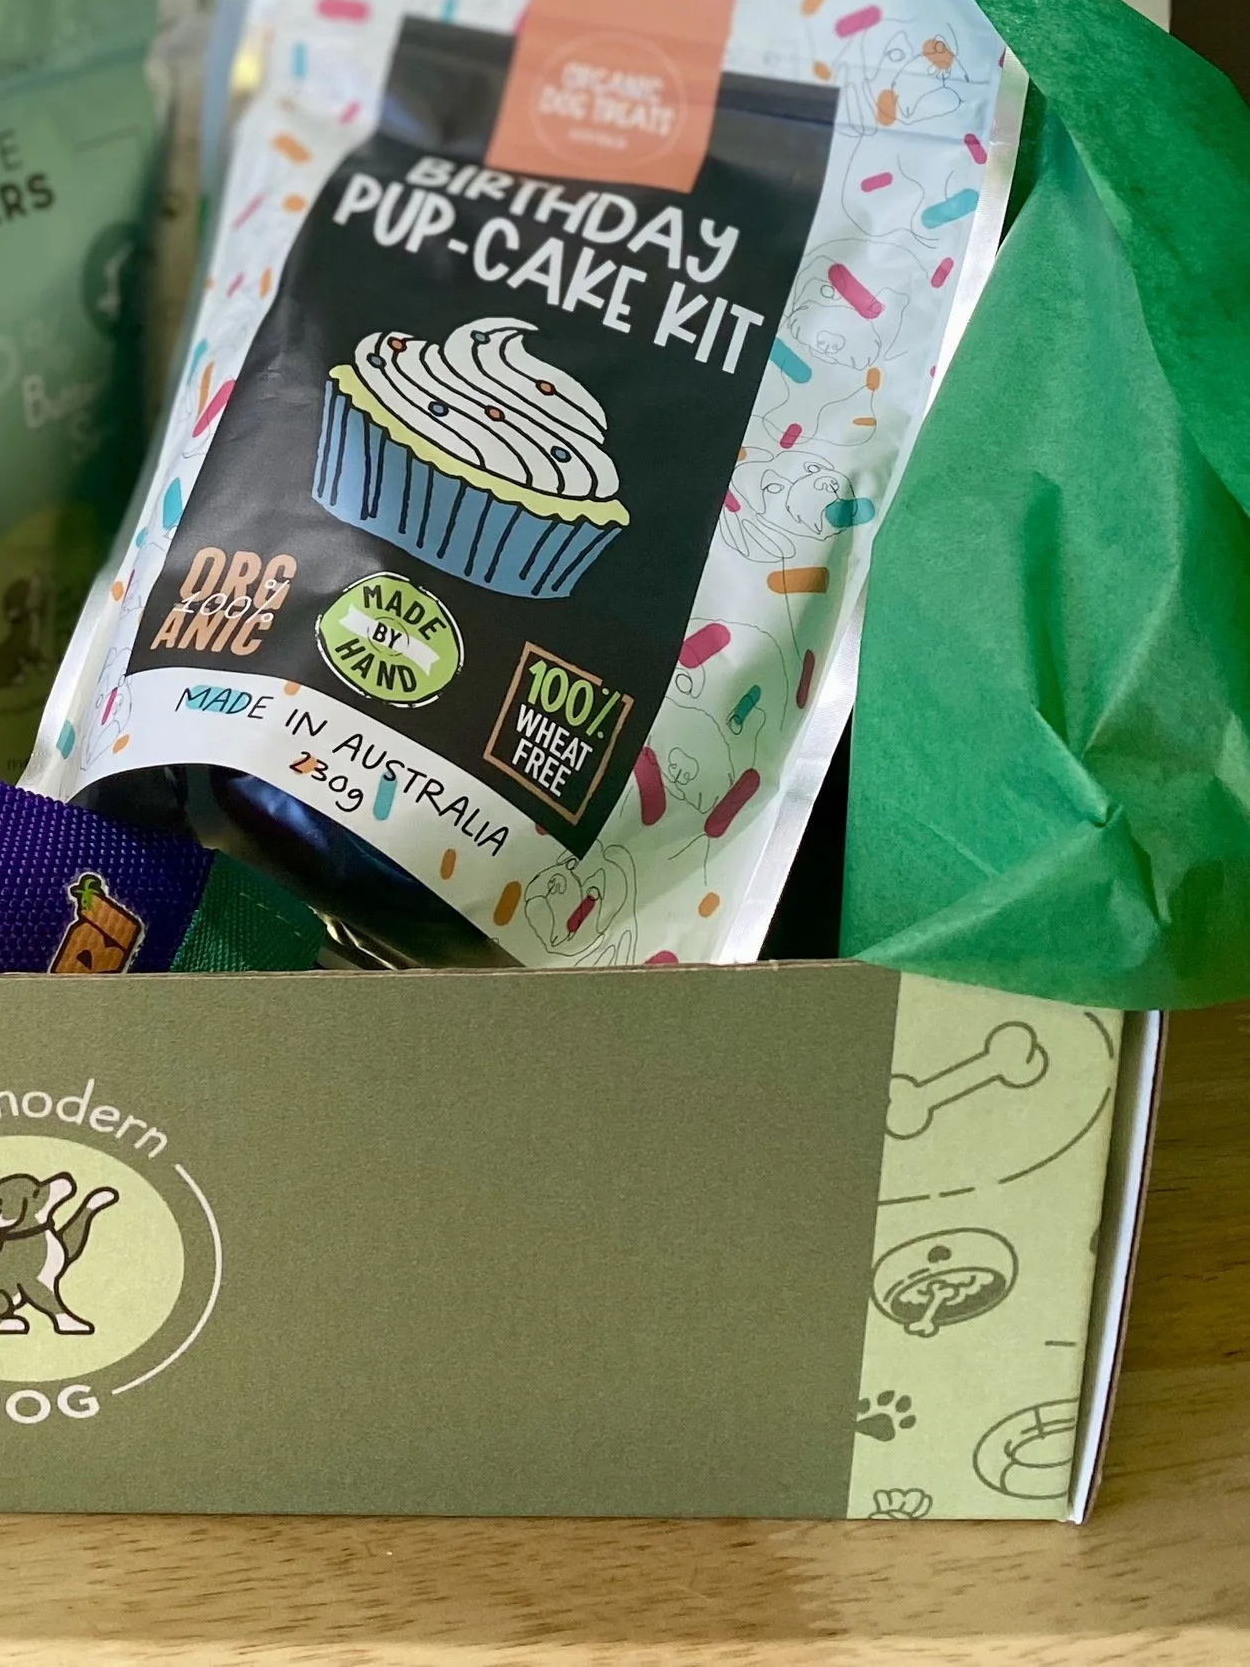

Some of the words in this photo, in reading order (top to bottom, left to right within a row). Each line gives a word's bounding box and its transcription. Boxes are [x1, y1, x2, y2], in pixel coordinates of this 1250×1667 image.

[406, 155, 739, 283] BIRTHDAY
[332, 173, 648, 333] PUP-CAKE
[653, 280, 766, 375] KIT
[173, 578, 290, 625] 100%
[179, 546, 298, 612] ORG
[150, 606, 274, 656] ANIC
[362, 584, 447, 642] MADE
[371, 621, 402, 650] BY
[334, 637, 418, 694] HAND
[527, 658, 621, 740] 100%
[511, 737, 572, 798] FREE
[515, 703, 594, 772] WHEAT
[174, 687, 275, 721] MADE
[285, 708, 329, 738] IN
[332, 733, 510, 858] AUSTRALIA
[289, 751, 365, 814] 230g
